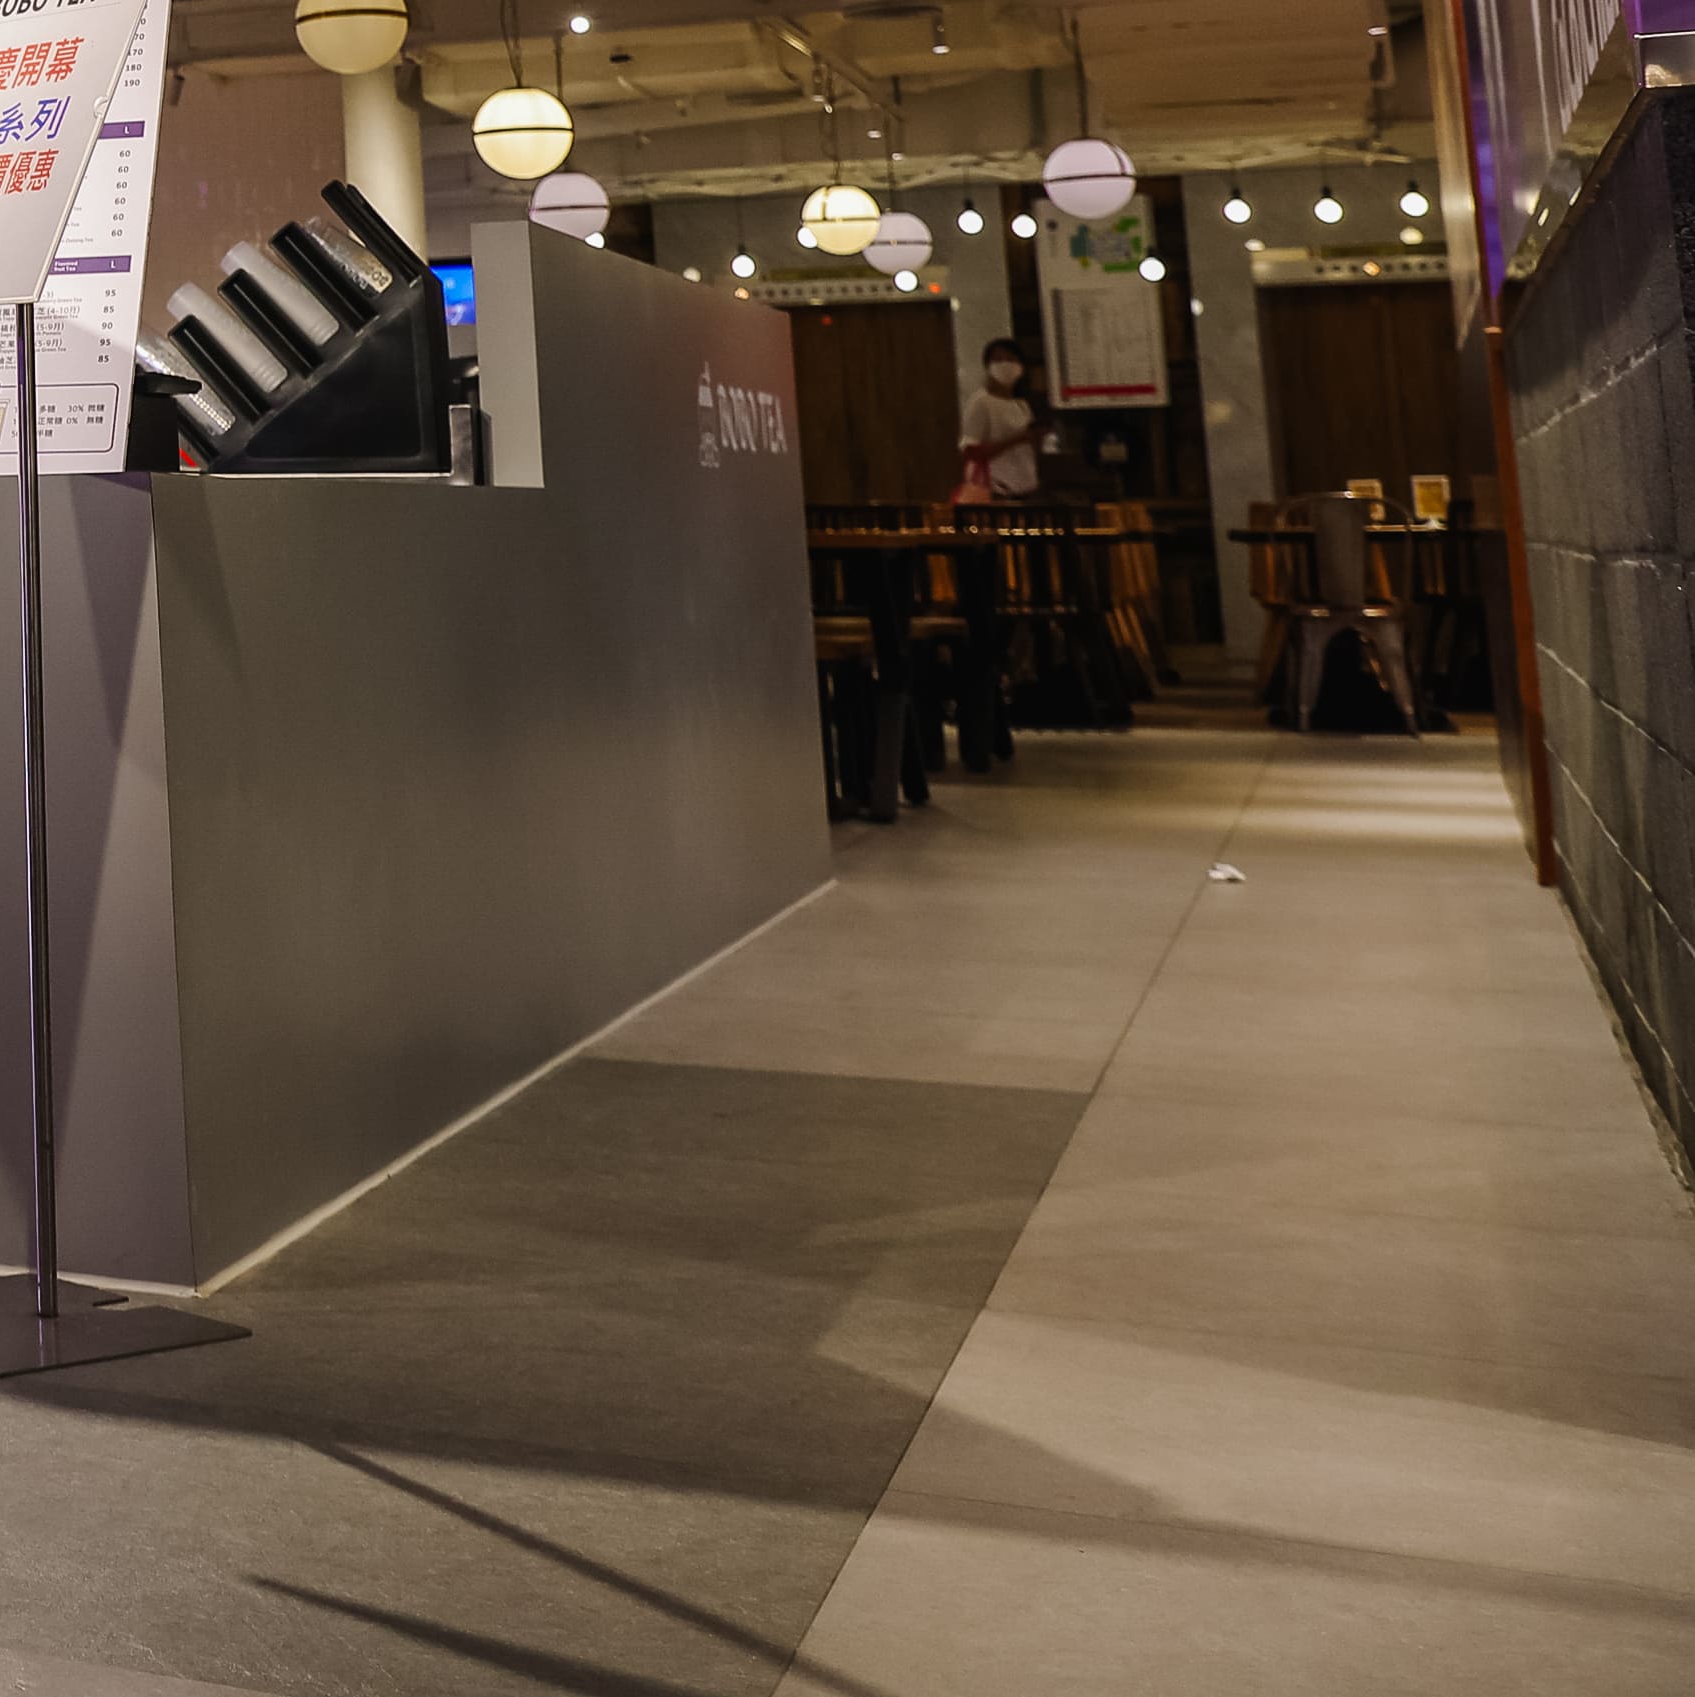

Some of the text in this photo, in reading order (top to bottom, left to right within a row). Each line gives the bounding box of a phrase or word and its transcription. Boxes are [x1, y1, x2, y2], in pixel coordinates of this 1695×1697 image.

[124, 79, 141, 87] 190
[105, 289, 116, 297] 95
[100, 338, 111, 346] 95
[98, 355, 109, 363] 85
[67, 405, 84, 413] 30%
[66, 417, 78, 425] 0%
